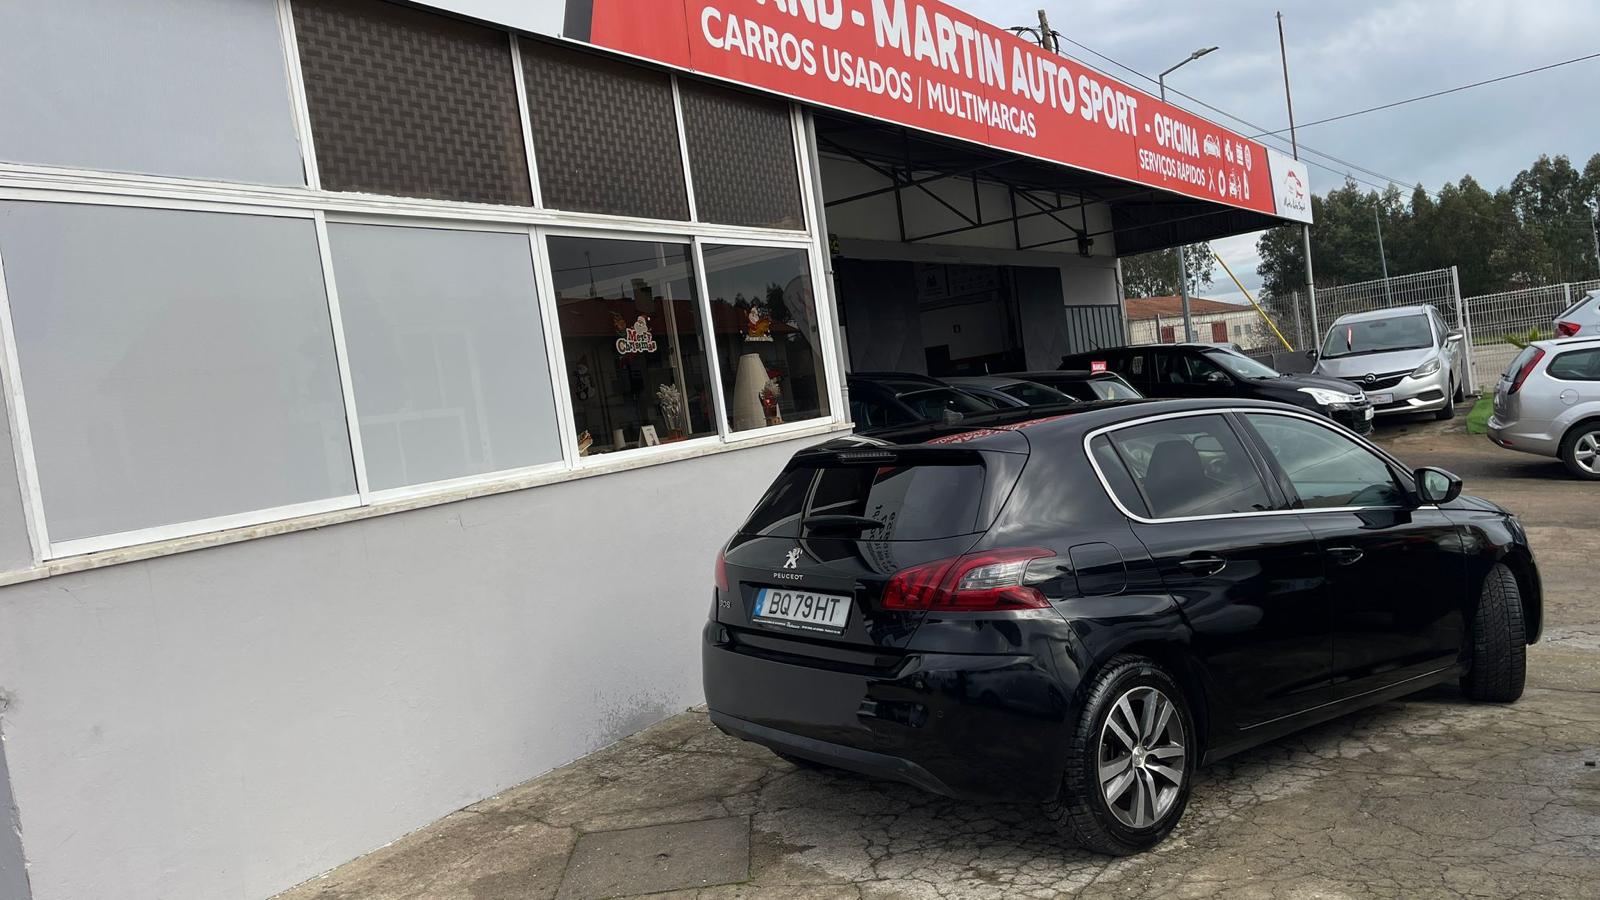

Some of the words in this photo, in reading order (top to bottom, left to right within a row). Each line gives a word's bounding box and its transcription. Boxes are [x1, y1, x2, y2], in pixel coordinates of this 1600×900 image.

[701, 6, 818, 76] CARROS
[821, 45, 914, 103] USADOS
[916, 76, 923, 110] /
[926, 79, 1037, 138] MULTIMARCAS
[871, 0, 1006, 91] MARTIN
[1011, 46, 1076, 115] AUTO
[1078, 74, 1138, 136] SPORT
[1153, 112, 1200, 160] OFICINA
[1138, 148, 1177, 181] SERVIÇOS
[1176, 157, 1206, 187] RÁPIDOS
[773, 572, 804, 581] PEUGEOT
[768, 591, 791, 616] BQ
